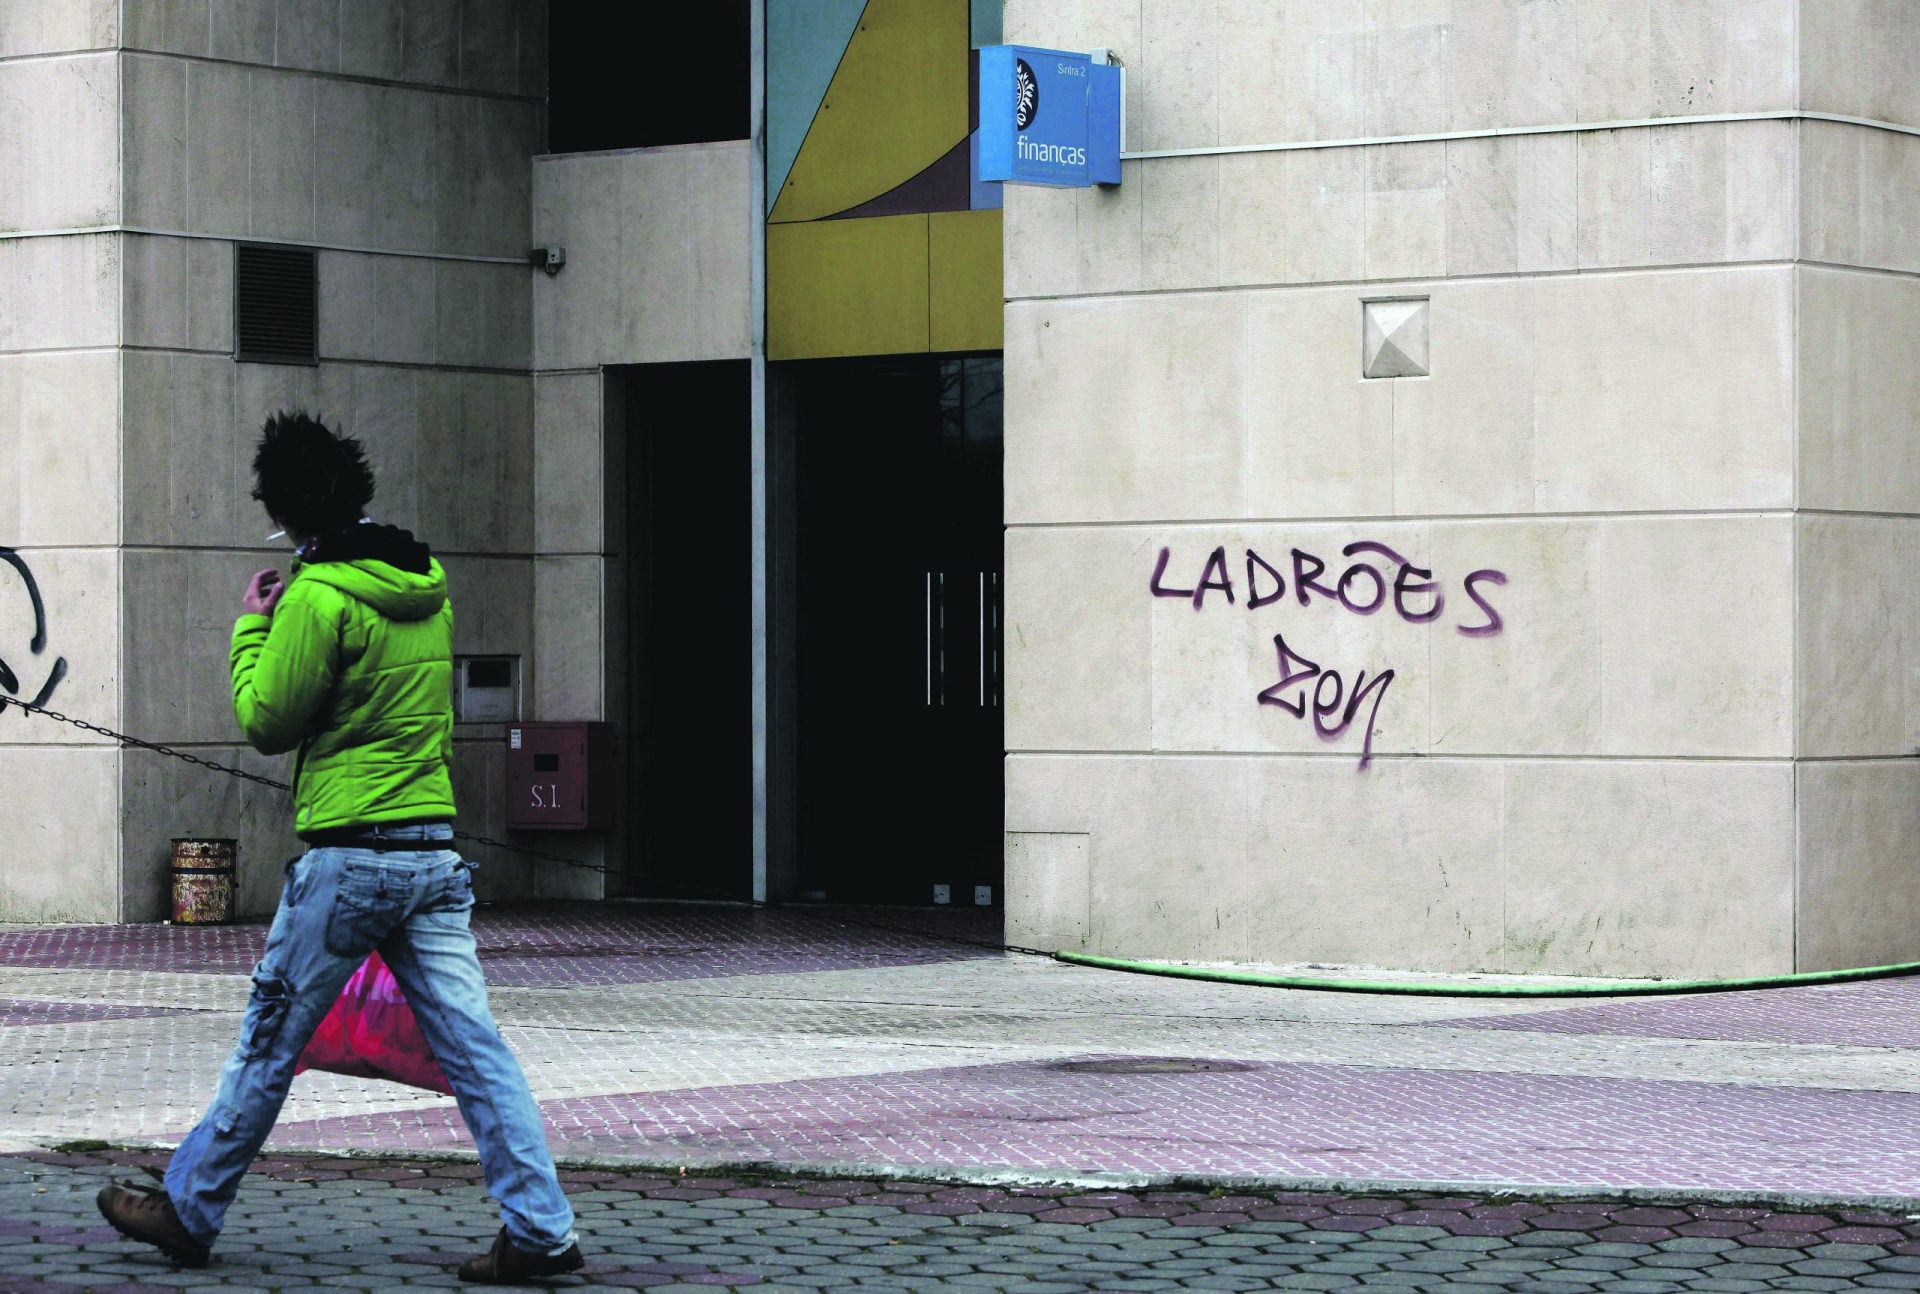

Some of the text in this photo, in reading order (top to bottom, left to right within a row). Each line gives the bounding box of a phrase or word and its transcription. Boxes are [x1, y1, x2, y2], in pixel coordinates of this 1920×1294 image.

[1057, 63, 1086, 77] Sintra 2
[1017, 134, 1086, 166] finanças
[1149, 540, 1509, 638] LADRÕES
